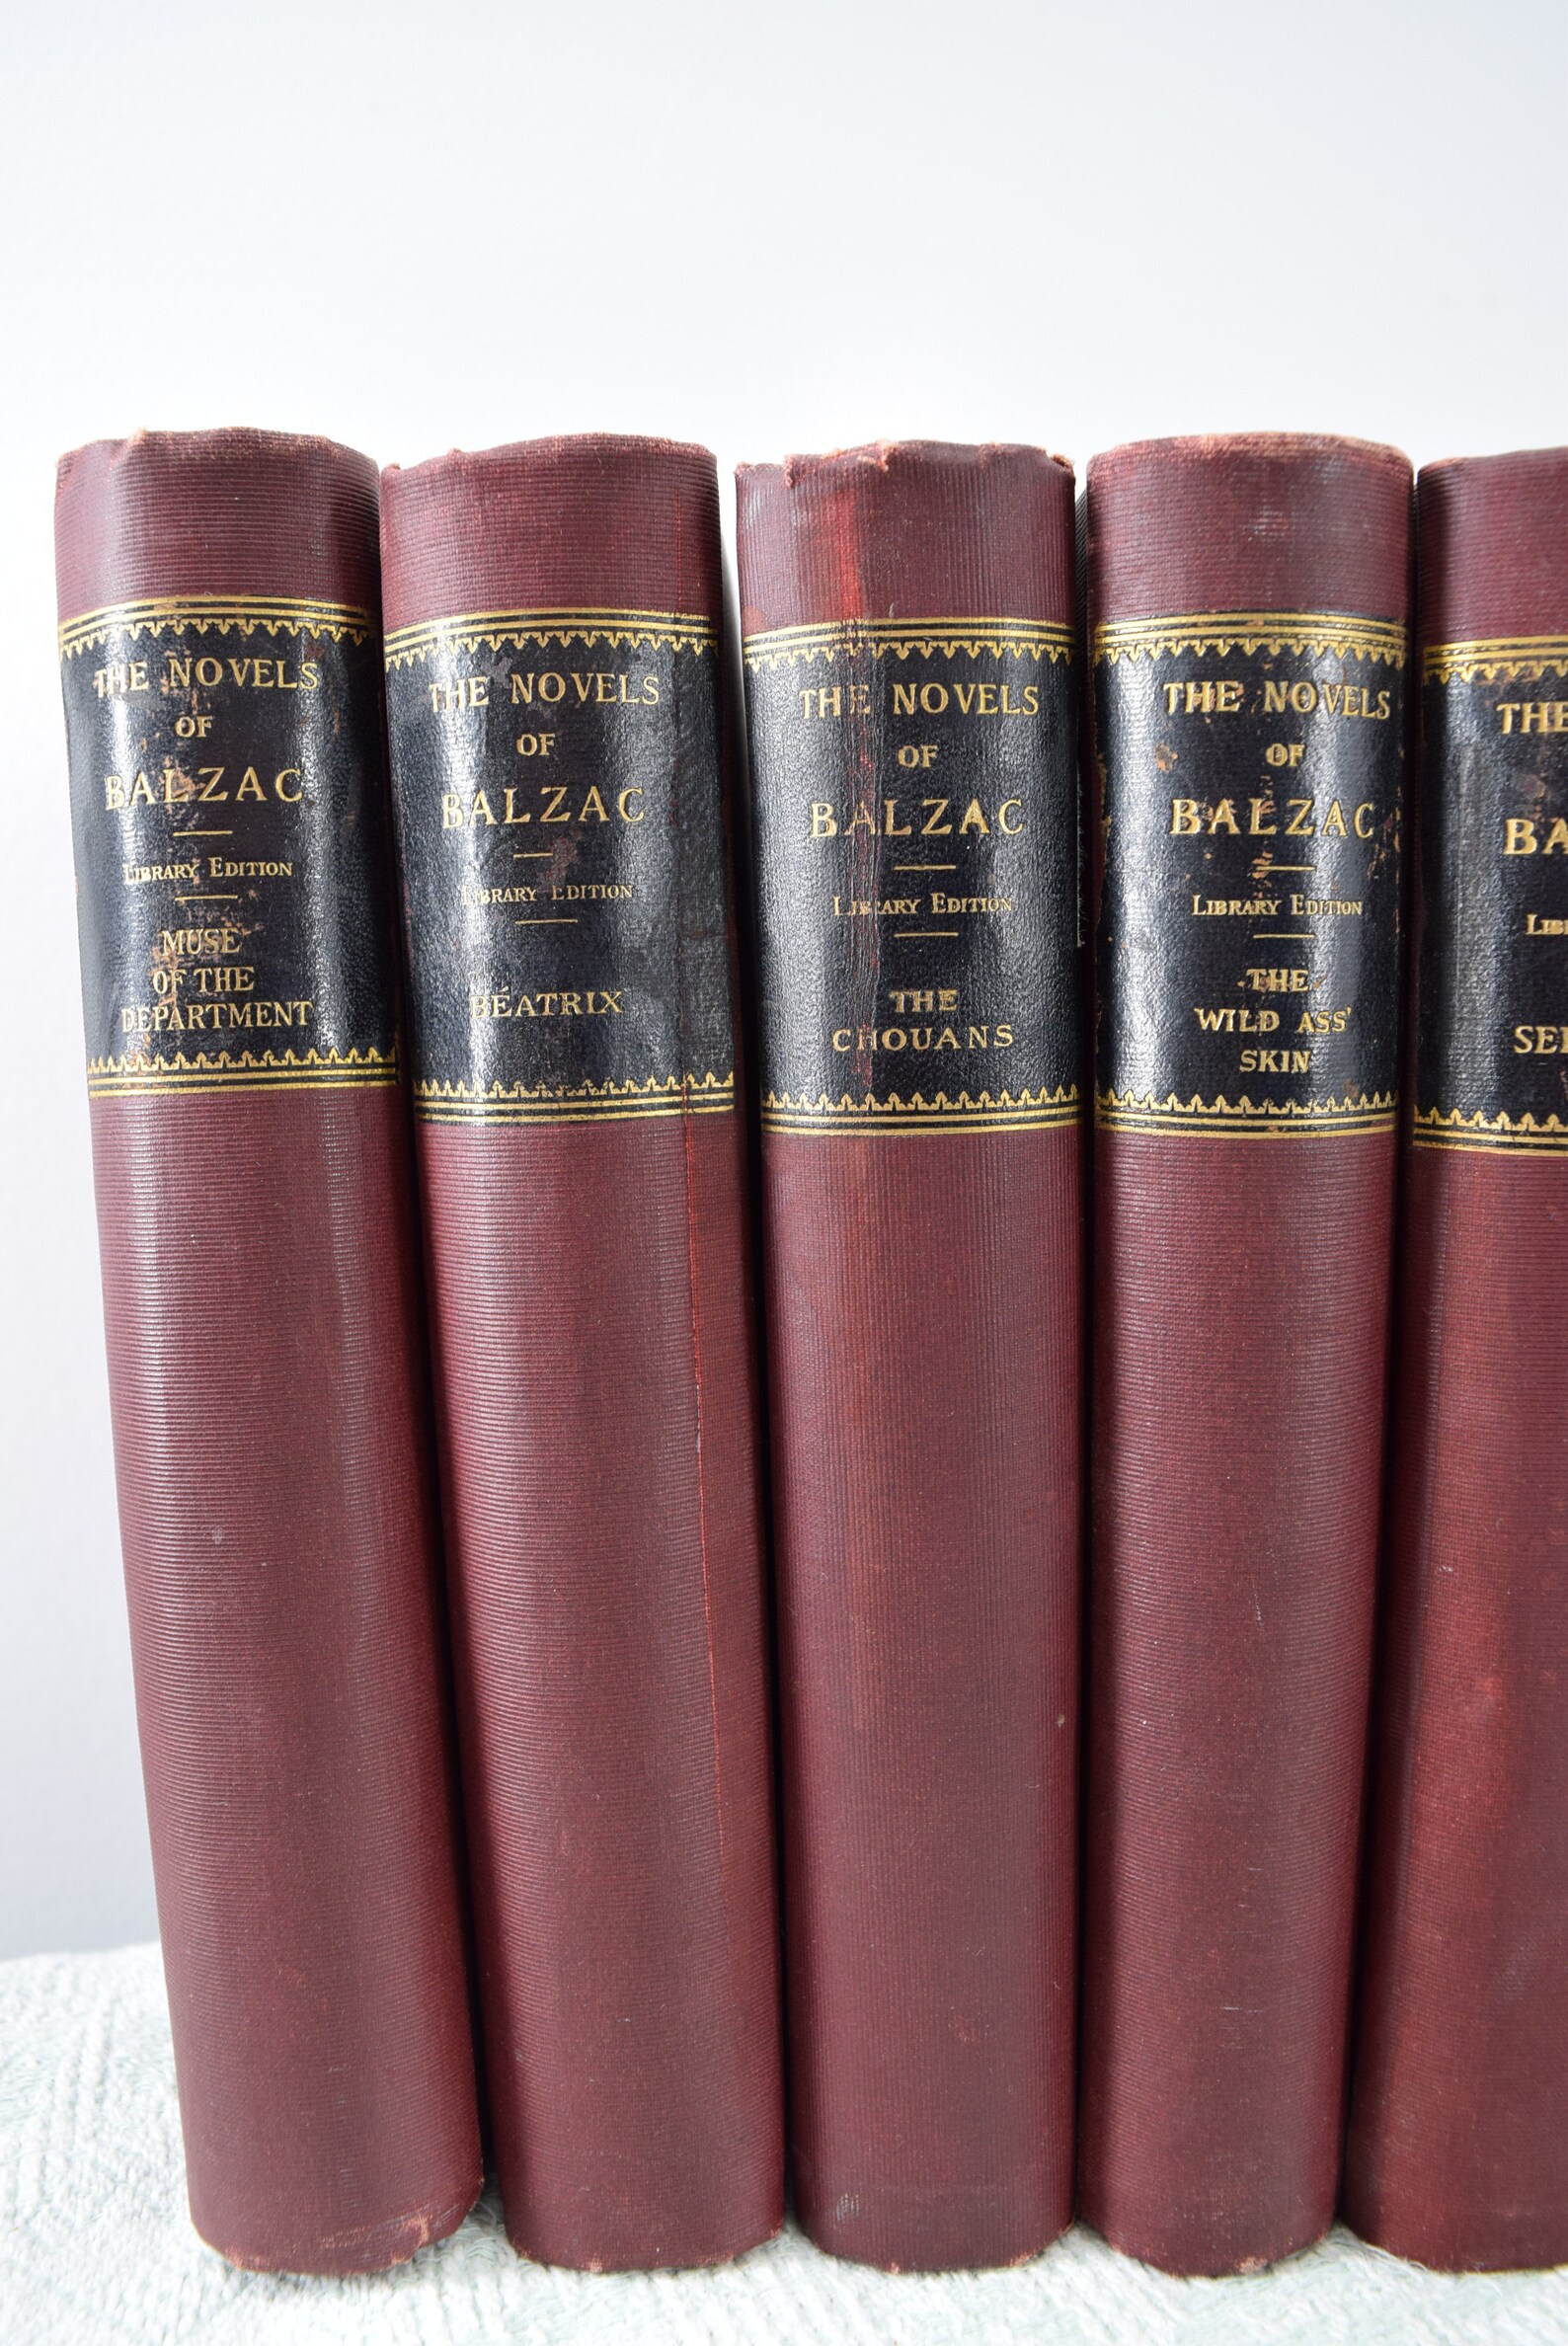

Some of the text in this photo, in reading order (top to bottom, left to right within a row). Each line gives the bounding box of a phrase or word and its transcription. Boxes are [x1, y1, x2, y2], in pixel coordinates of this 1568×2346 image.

[95, 658, 318, 698] THE NOVELS
[430, 671, 661, 713] THE NOVELS
[799, 683, 1039, 719] THE NOVELS
[1163, 681, 1390, 720] THE NOVELS
[176, 716, 212, 738] OF
[516, 734, 555, 756] OF
[898, 745, 938, 768] OF
[1266, 743, 1305, 766] OF
[105, 767, 303, 811] BALZAC
[441, 787, 645, 828] BALZAC
[810, 799, 1024, 838] BALZAC
[1170, 798, 1374, 837] BALZAC
[161, 929, 241, 956] MUSE
[152, 967, 255, 994] OF THE
[1246, 969, 1309, 992] THE
[889, 989, 958, 1013] THE
[121, 1002, 312, 1033] DEPARTMENT
[1194, 1008, 1280, 1033] WILD
[832, 1025, 1014, 1053] CHOUANS
[1239, 1050, 1311, 1073] SKIN
